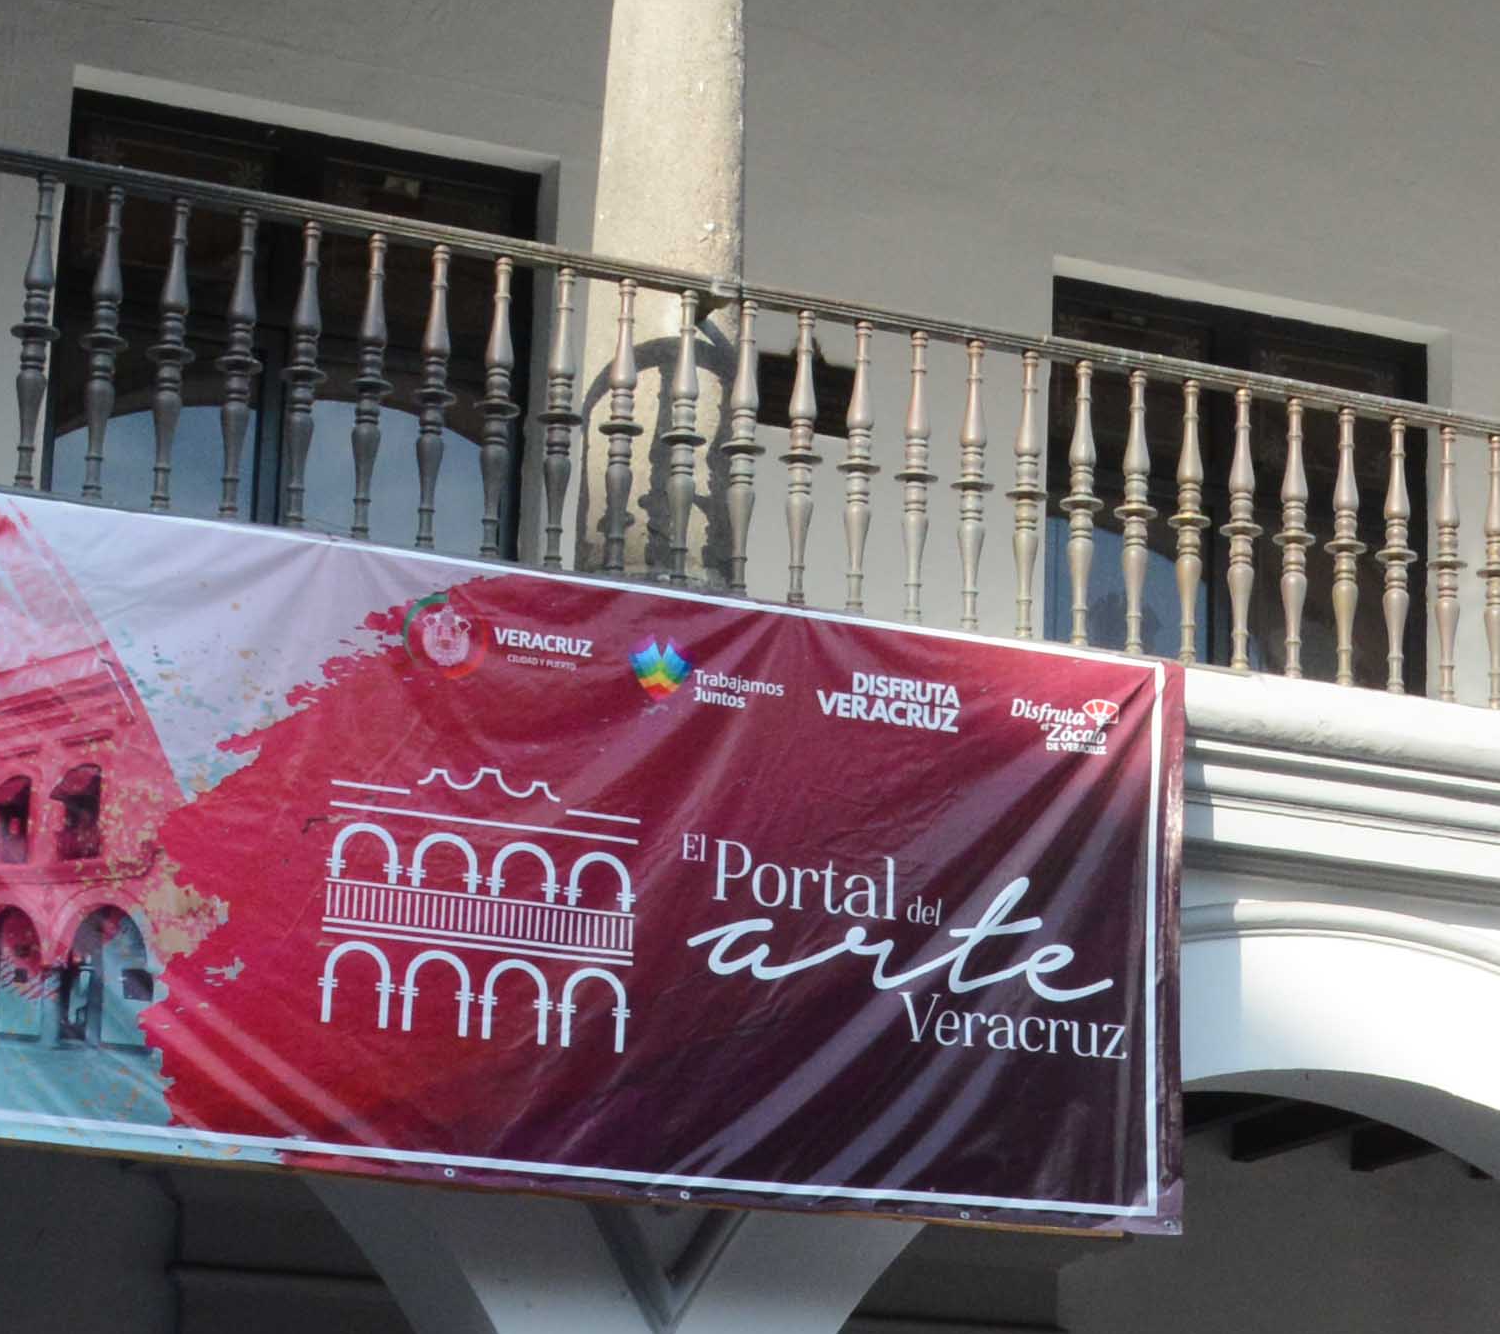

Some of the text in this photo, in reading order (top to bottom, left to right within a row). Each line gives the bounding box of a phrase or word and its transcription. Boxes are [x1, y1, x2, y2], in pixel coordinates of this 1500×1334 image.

[494, 627, 594, 658] VERACRUZ
[507, 654, 578, 672] CIUDAD Y PUERTO
[693, 669, 785, 698] Trabajamos
[693, 687, 747, 709] Juntos
[852, 671, 961, 708] DISFRUTA
[816, 689, 960, 734] VERACRUZ
[1010, 698, 1086, 726] Disfruta
[1045, 722, 1108, 744] Zócalo
[1046, 742, 1108, 756] DE VERACRUZ
[682, 833, 942, 926] El Portal del
[686, 877, 1114, 1002] arte
[899, 991, 1128, 1060] Veracruz
